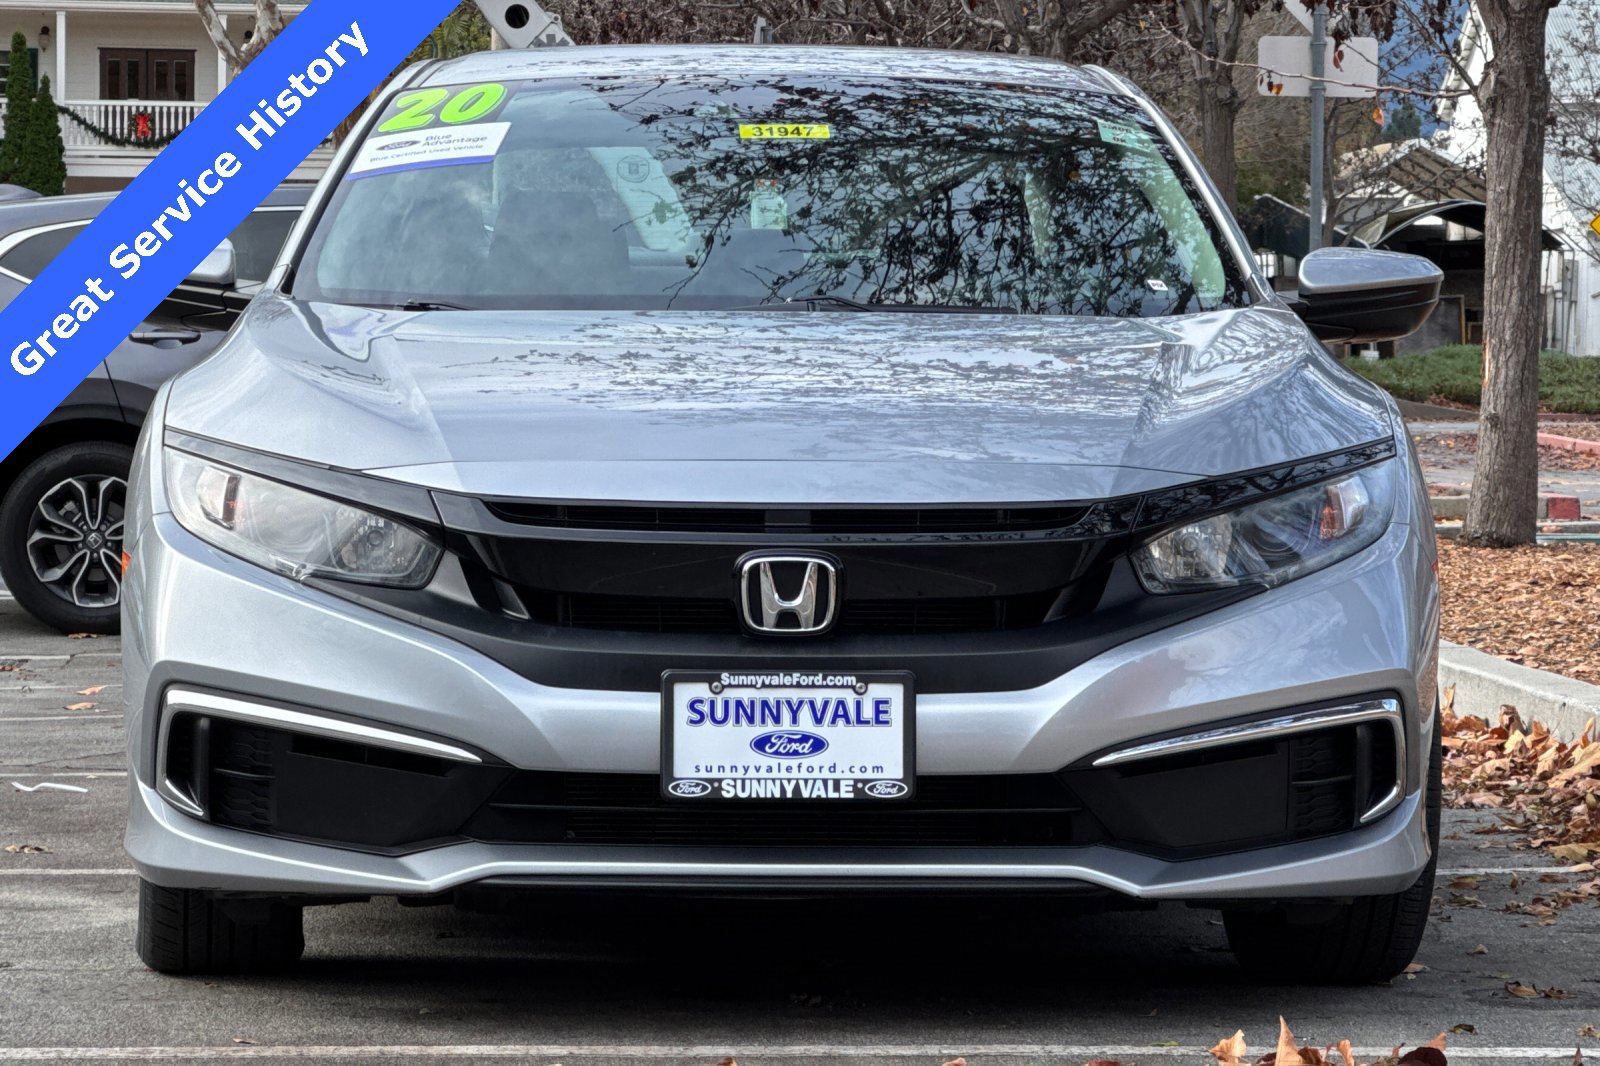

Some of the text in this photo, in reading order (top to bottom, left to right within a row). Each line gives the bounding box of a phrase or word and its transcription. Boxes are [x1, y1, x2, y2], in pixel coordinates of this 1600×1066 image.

[377, 83, 508, 133] 20
[751, 126, 814, 137] 31947
[422, 136, 488, 147] Advantage
[721, 673, 857, 689] SunnyvaleFord.com
[686, 697, 892, 727] SUNNYVALE
[765, 733, 814, 754] Ford
[694, 762, 884, 776] sunnyvaleford.com
[676, 779, 900, 798] Ford SUNNYVALE Ford
